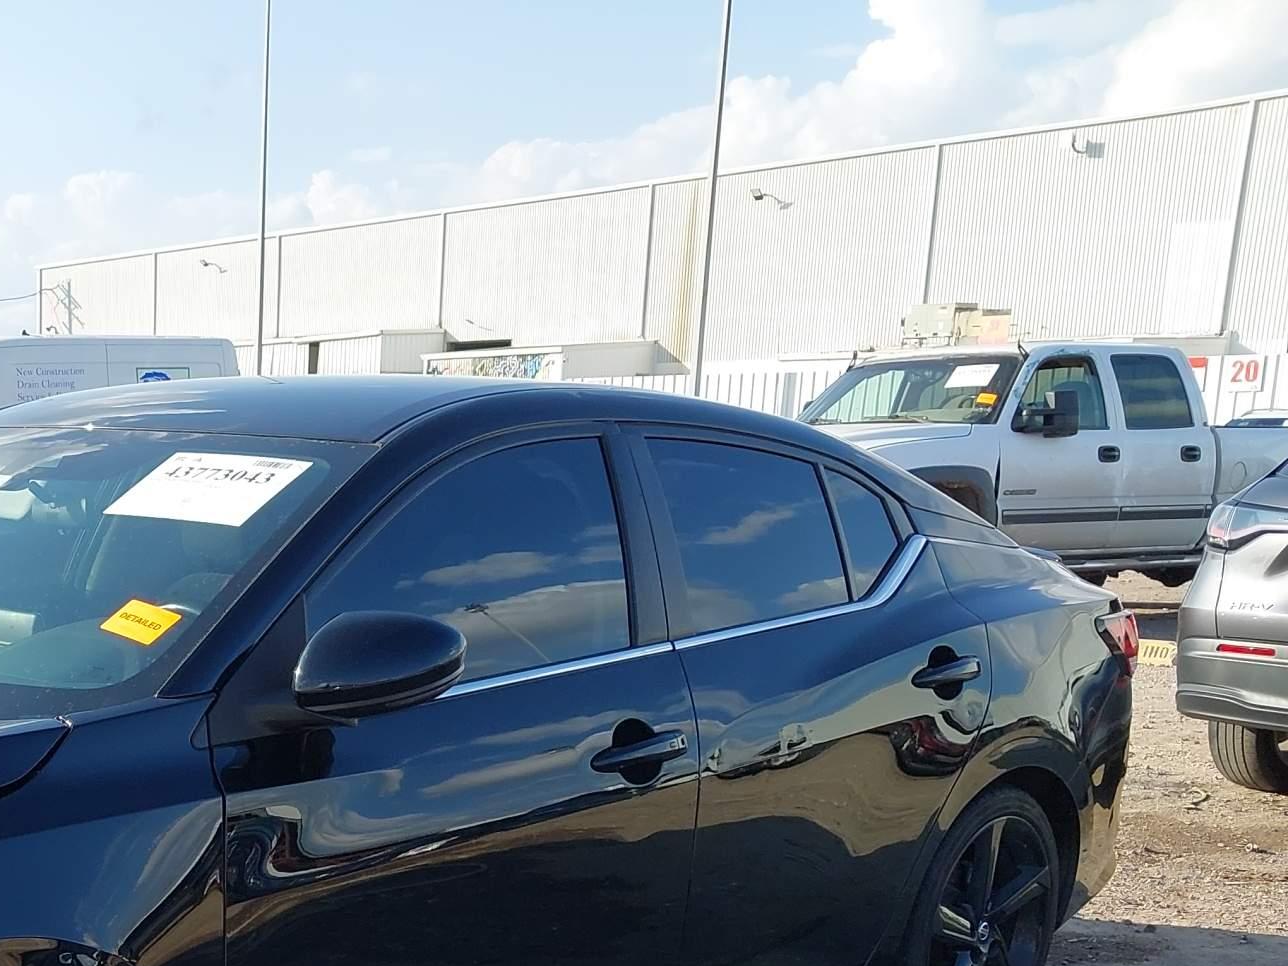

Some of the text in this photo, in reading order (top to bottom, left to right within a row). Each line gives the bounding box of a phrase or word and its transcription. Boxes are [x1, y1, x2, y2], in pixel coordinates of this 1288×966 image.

[16, 367, 85, 377] New Construction
[1230, 360, 1260, 383] 20
[17, 379, 76, 390] Drain Cleaning
[164, 465, 276, 484] 43773043
[119, 612, 162, 631] DETAILED
